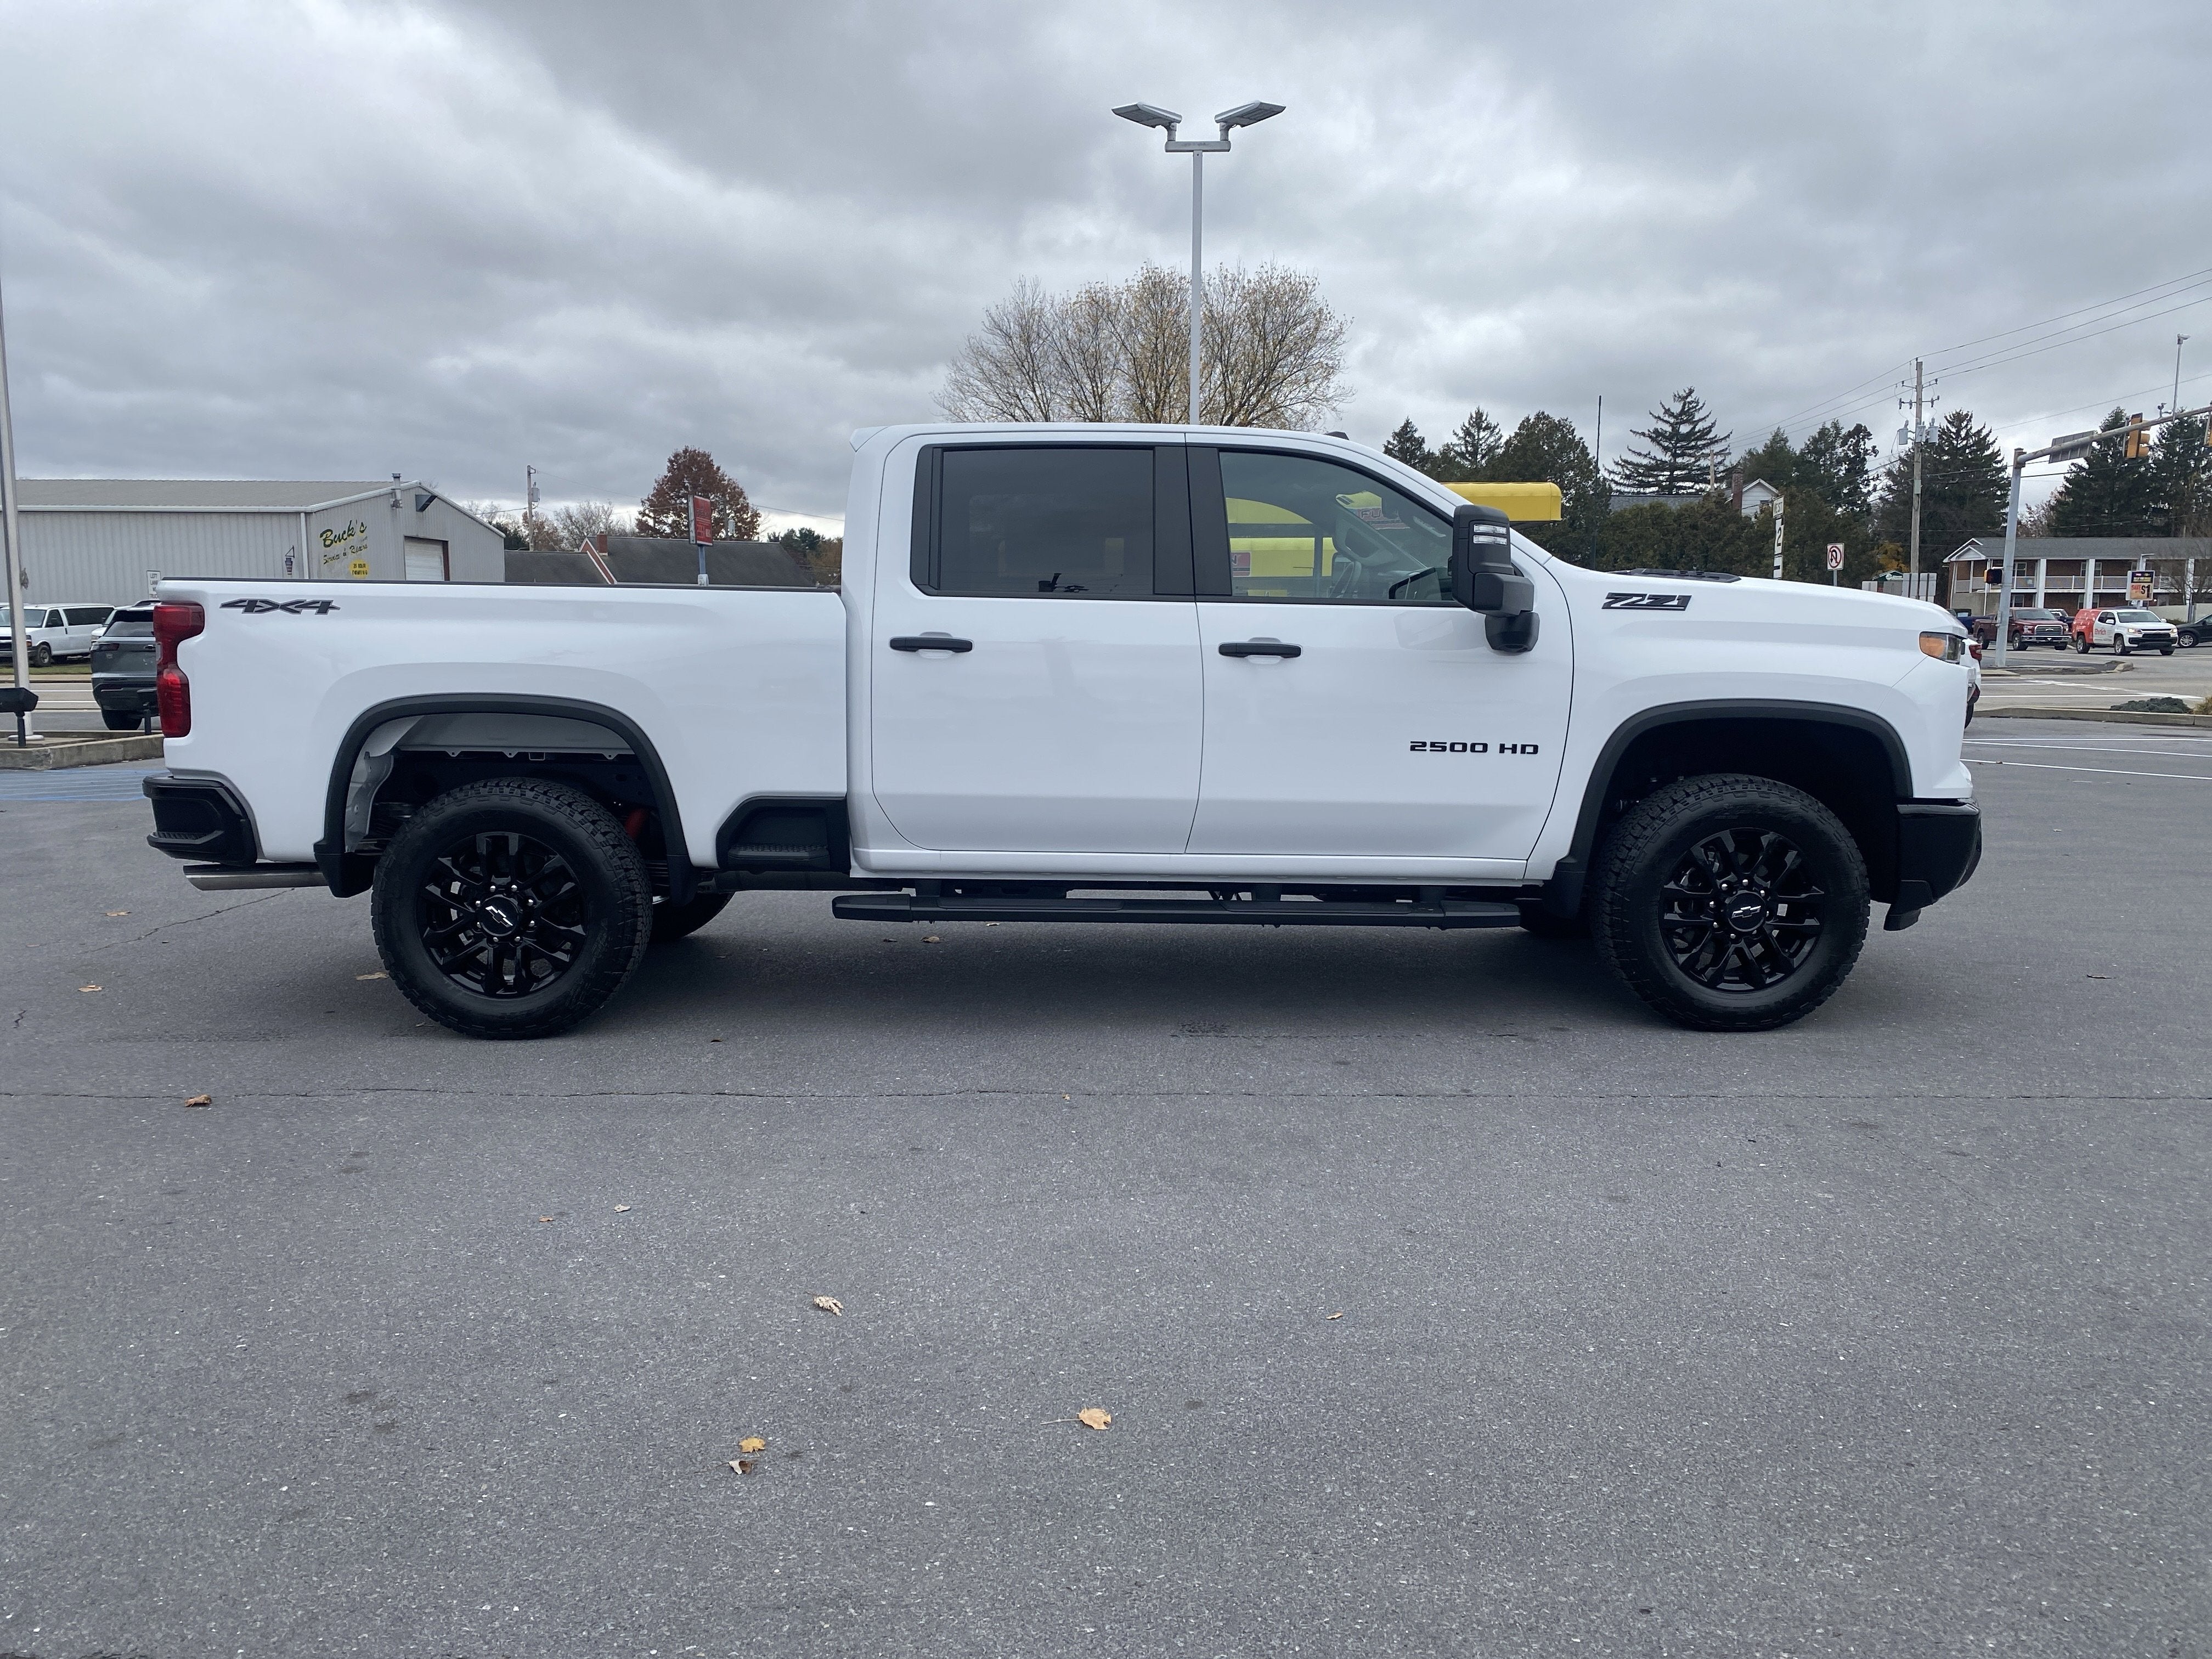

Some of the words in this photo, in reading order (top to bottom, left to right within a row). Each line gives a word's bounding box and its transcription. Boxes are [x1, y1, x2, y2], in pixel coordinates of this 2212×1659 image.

[320, 520, 367, 548] Buck's
[1601, 592, 1692, 611] Z71
[1410, 741, 1488, 753] 2500
[1499, 743, 1539, 755] HD
